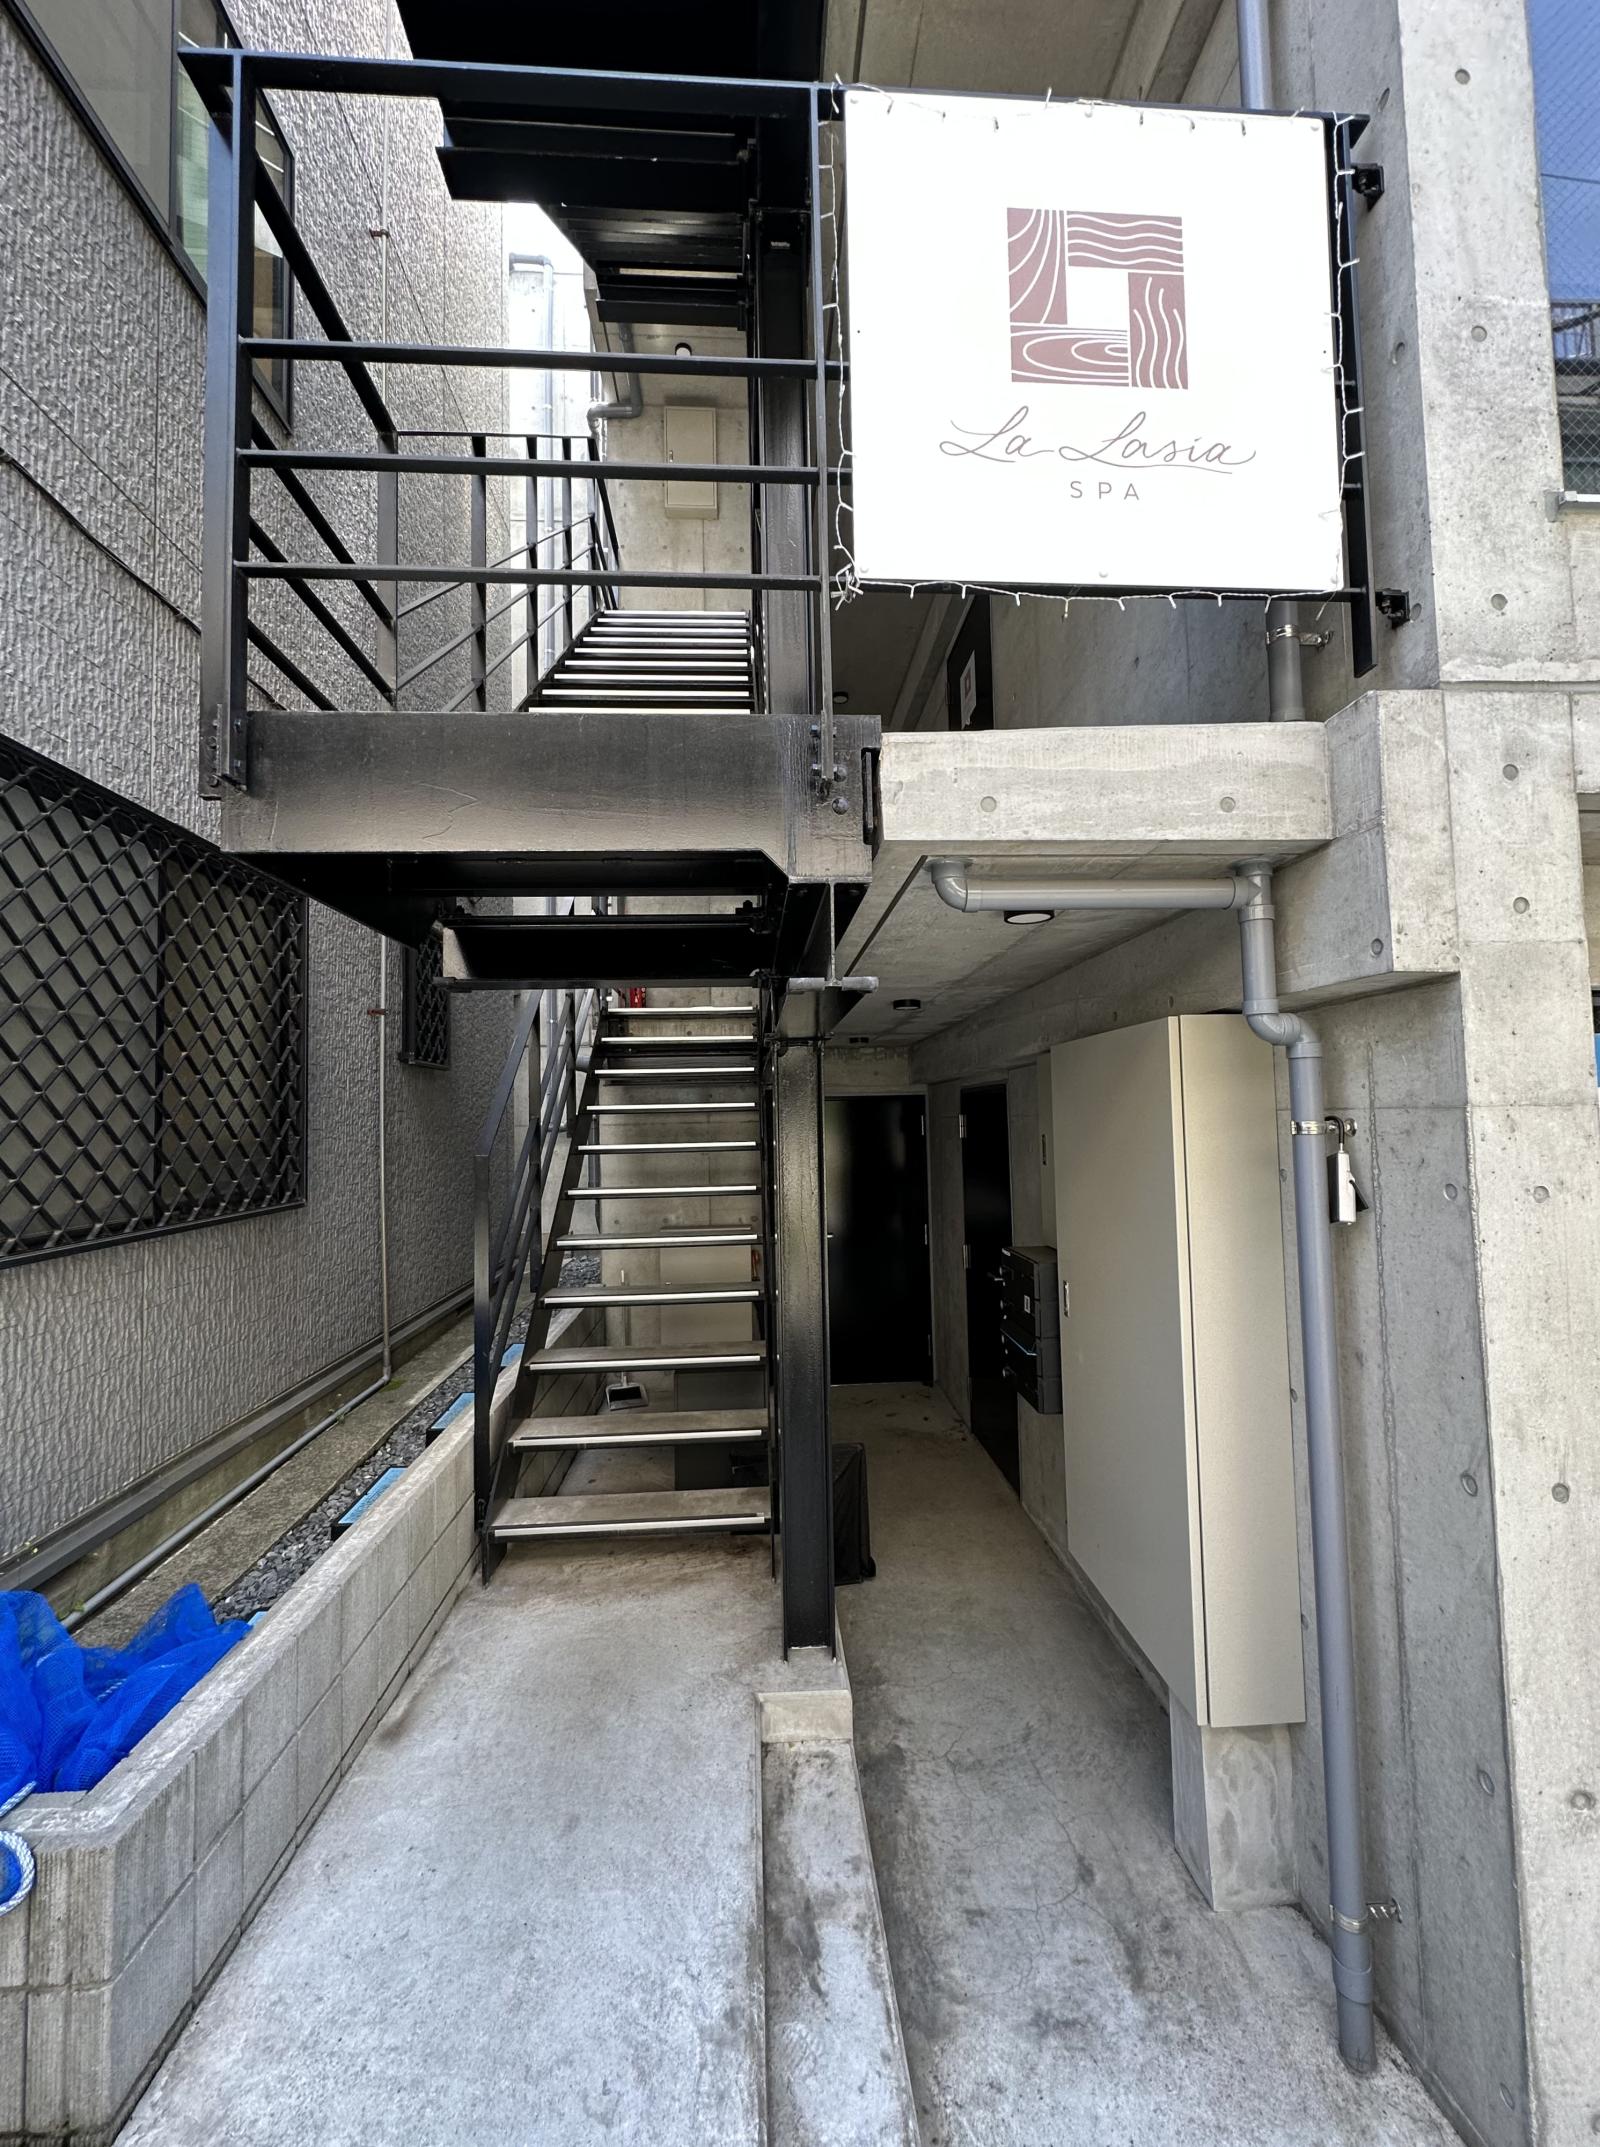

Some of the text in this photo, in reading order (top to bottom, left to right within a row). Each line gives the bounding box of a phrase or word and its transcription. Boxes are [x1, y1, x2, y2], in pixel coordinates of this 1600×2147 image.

[939, 405, 1257, 474] La Lasia
[1070, 481, 1140, 500] SPA
